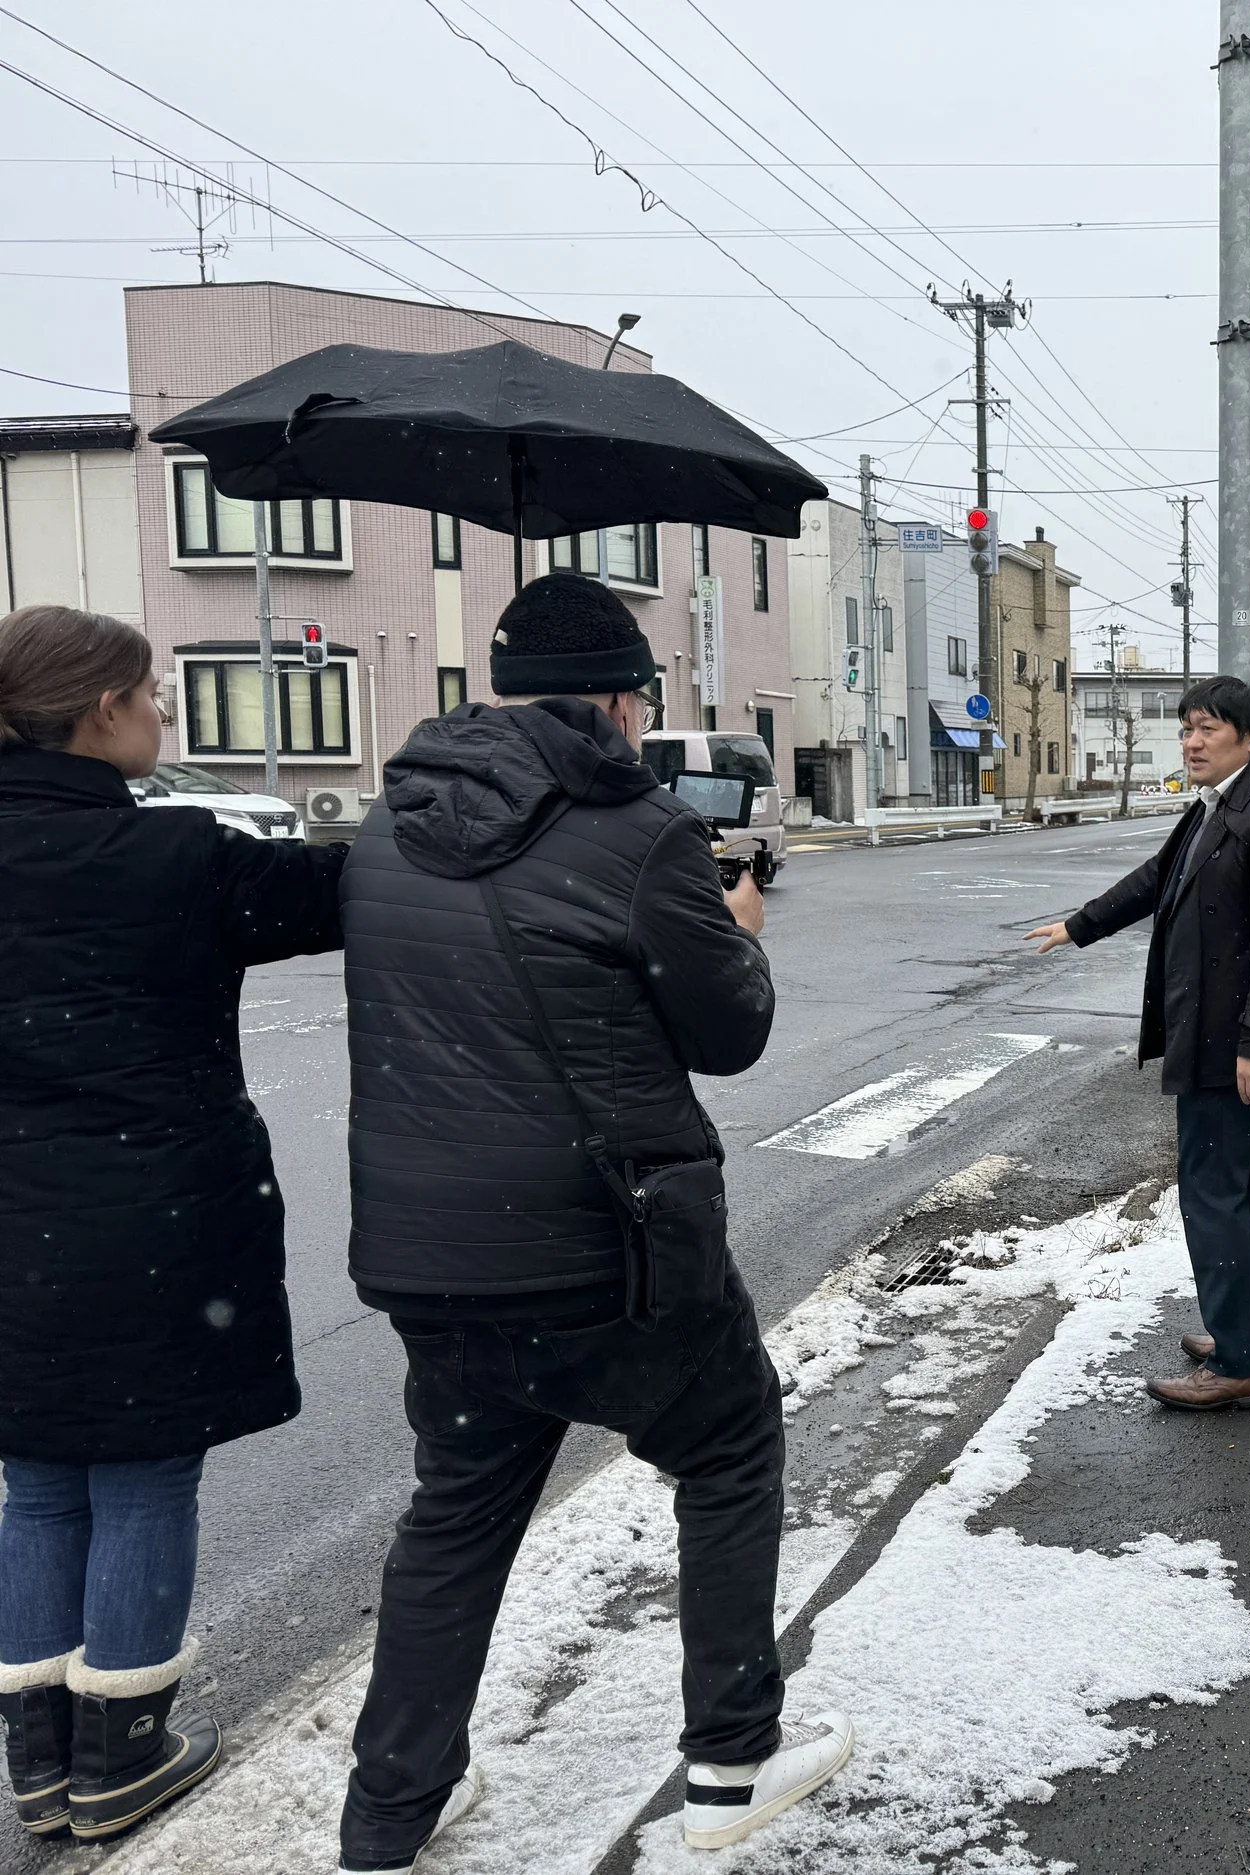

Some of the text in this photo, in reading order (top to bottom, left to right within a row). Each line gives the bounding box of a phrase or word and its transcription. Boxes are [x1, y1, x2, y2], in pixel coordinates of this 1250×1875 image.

[903, 529, 937, 541] 住吉町
[1237, 611, 1247, 620] 20
[703, 599, 714, 703] 毛利整形外科クリニック
